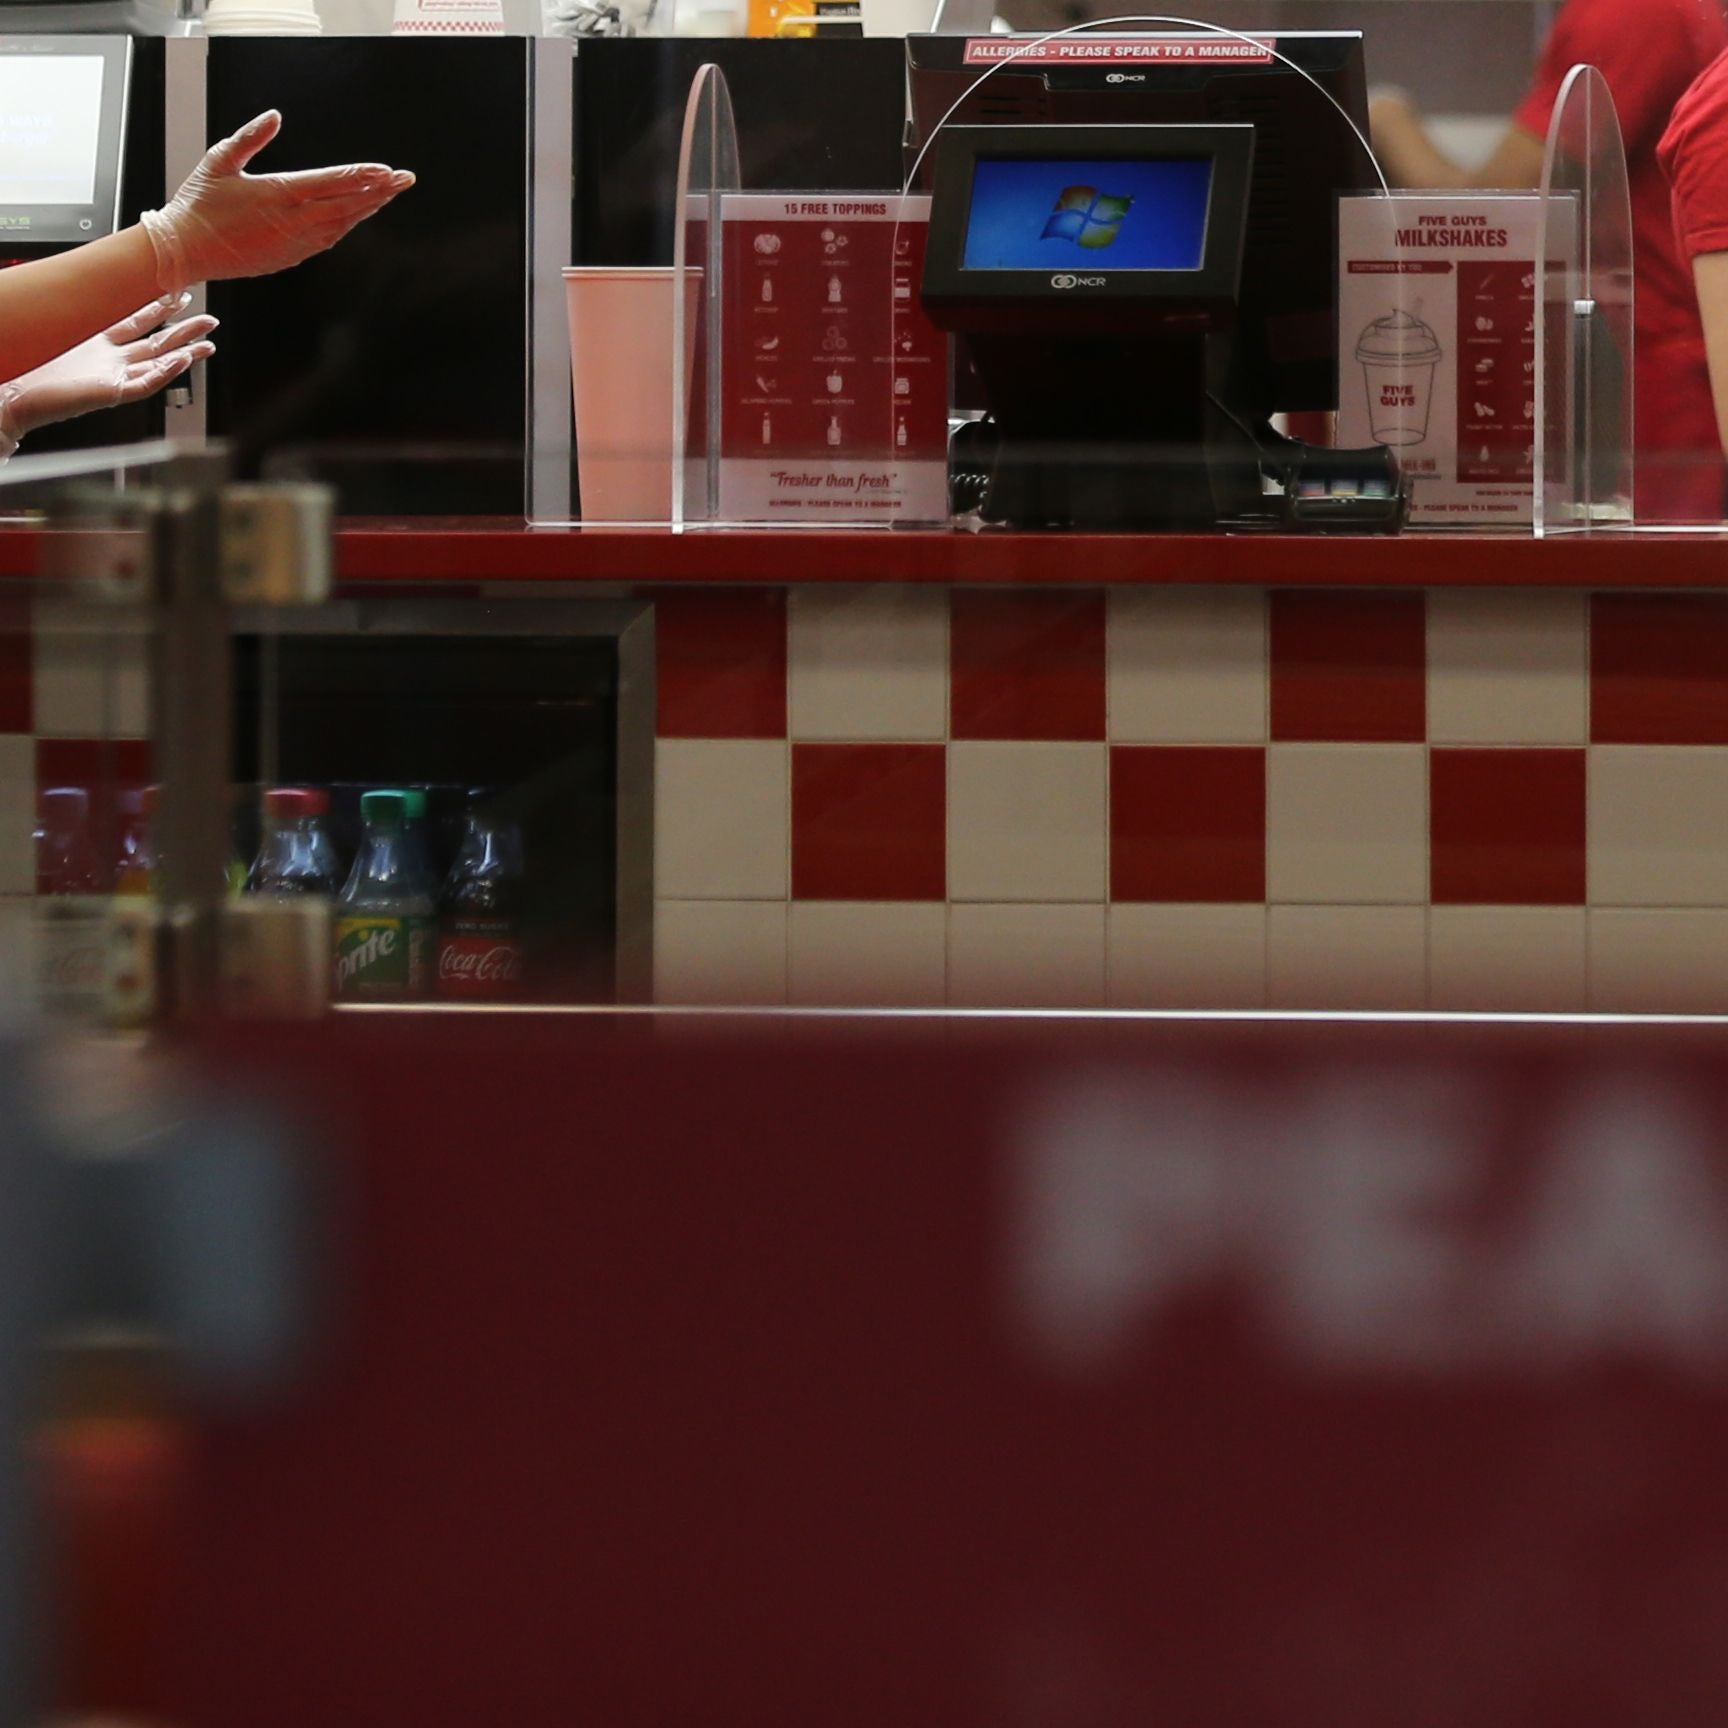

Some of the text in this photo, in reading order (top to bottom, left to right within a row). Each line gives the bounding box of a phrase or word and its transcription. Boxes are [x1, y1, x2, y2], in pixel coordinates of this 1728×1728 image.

[784, 202, 887, 216] 15 FREE TOPPINGS
[1418, 215, 1487, 227] FIVE GUYS
[1394, 228, 1508, 248] MILKSHAKES
[1078, 276, 1107, 287] NCR
[1382, 384, 1414, 396] FIVE
[1380, 396, 1416, 407] GUYS
[825, 473, 854, 488] than
[338, 930, 395, 992] prite
